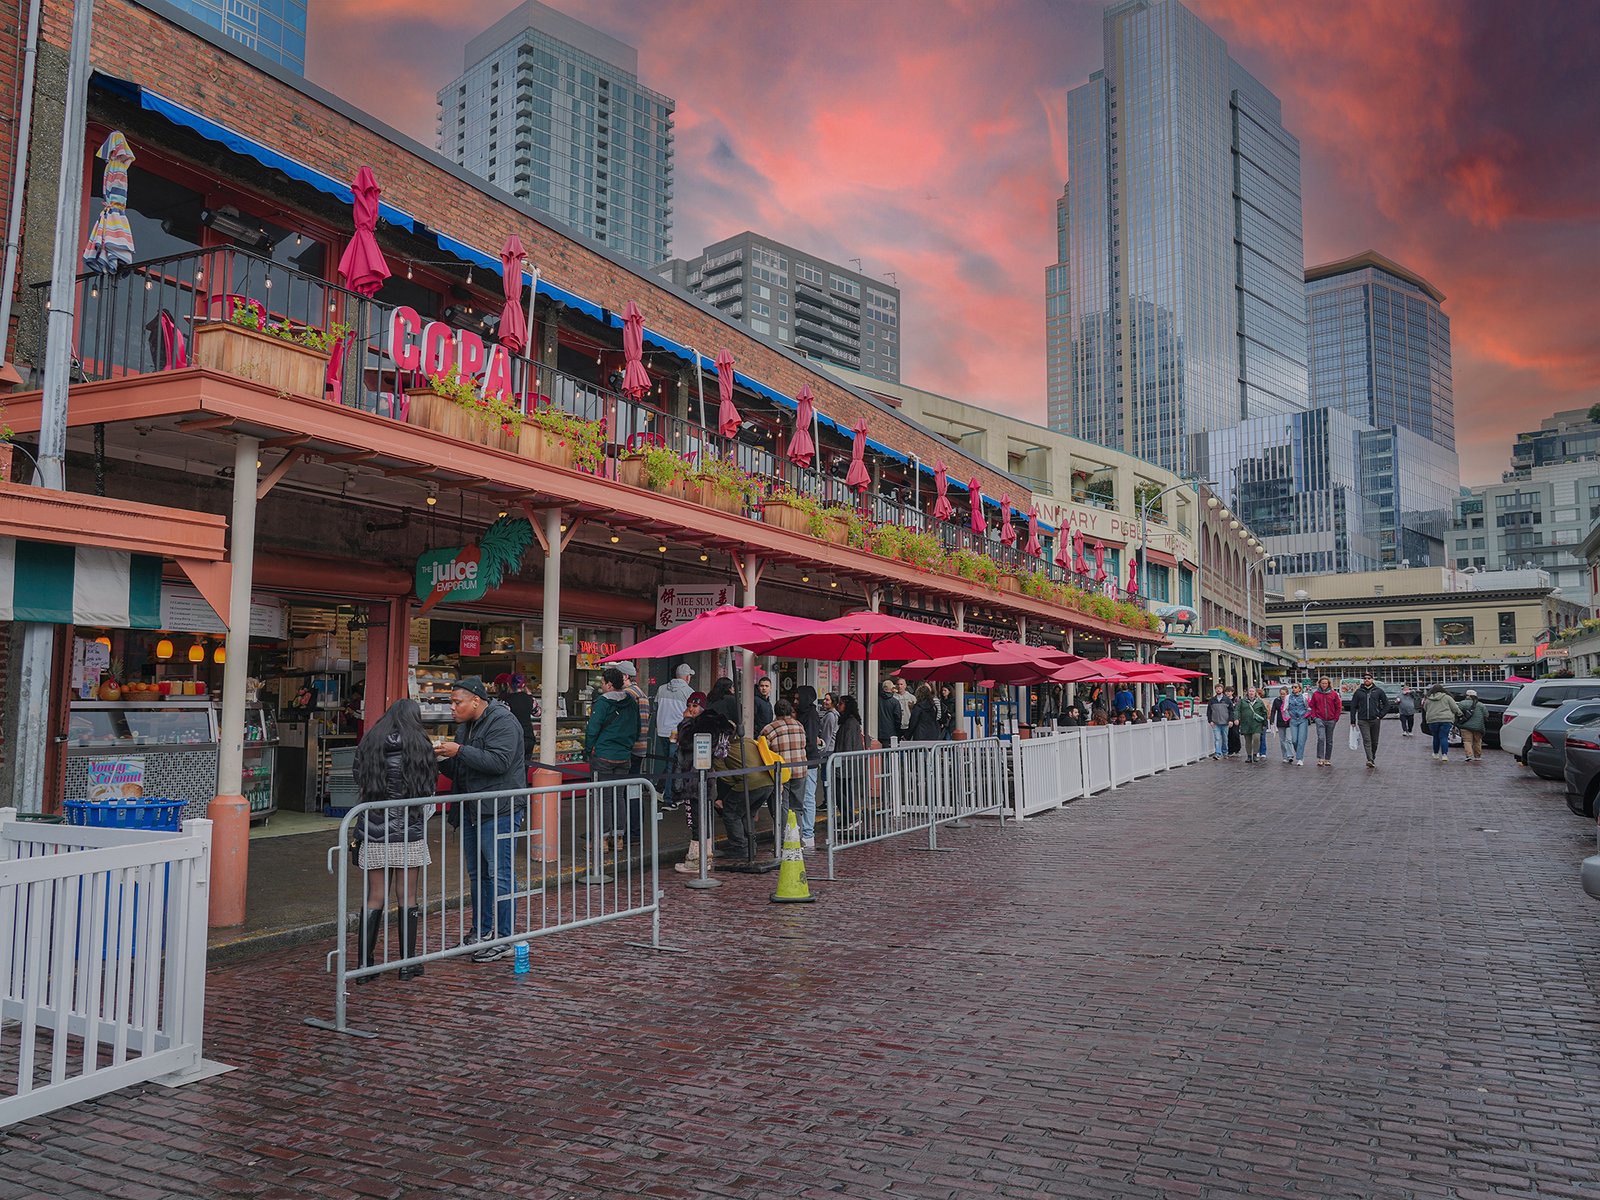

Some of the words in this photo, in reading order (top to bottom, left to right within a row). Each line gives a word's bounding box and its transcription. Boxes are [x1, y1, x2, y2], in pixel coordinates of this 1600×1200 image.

[388, 305, 513, 404] COPA
[421, 565, 433, 574] THE
[430, 559, 478, 586] juice
[436, 580, 478, 592] EMPORIUM
[676, 597, 693, 606] MEE
[695, 597, 714, 606] SUM
[580, 640, 599, 655] TAKE
[600, 642, 617, 655] OUT
